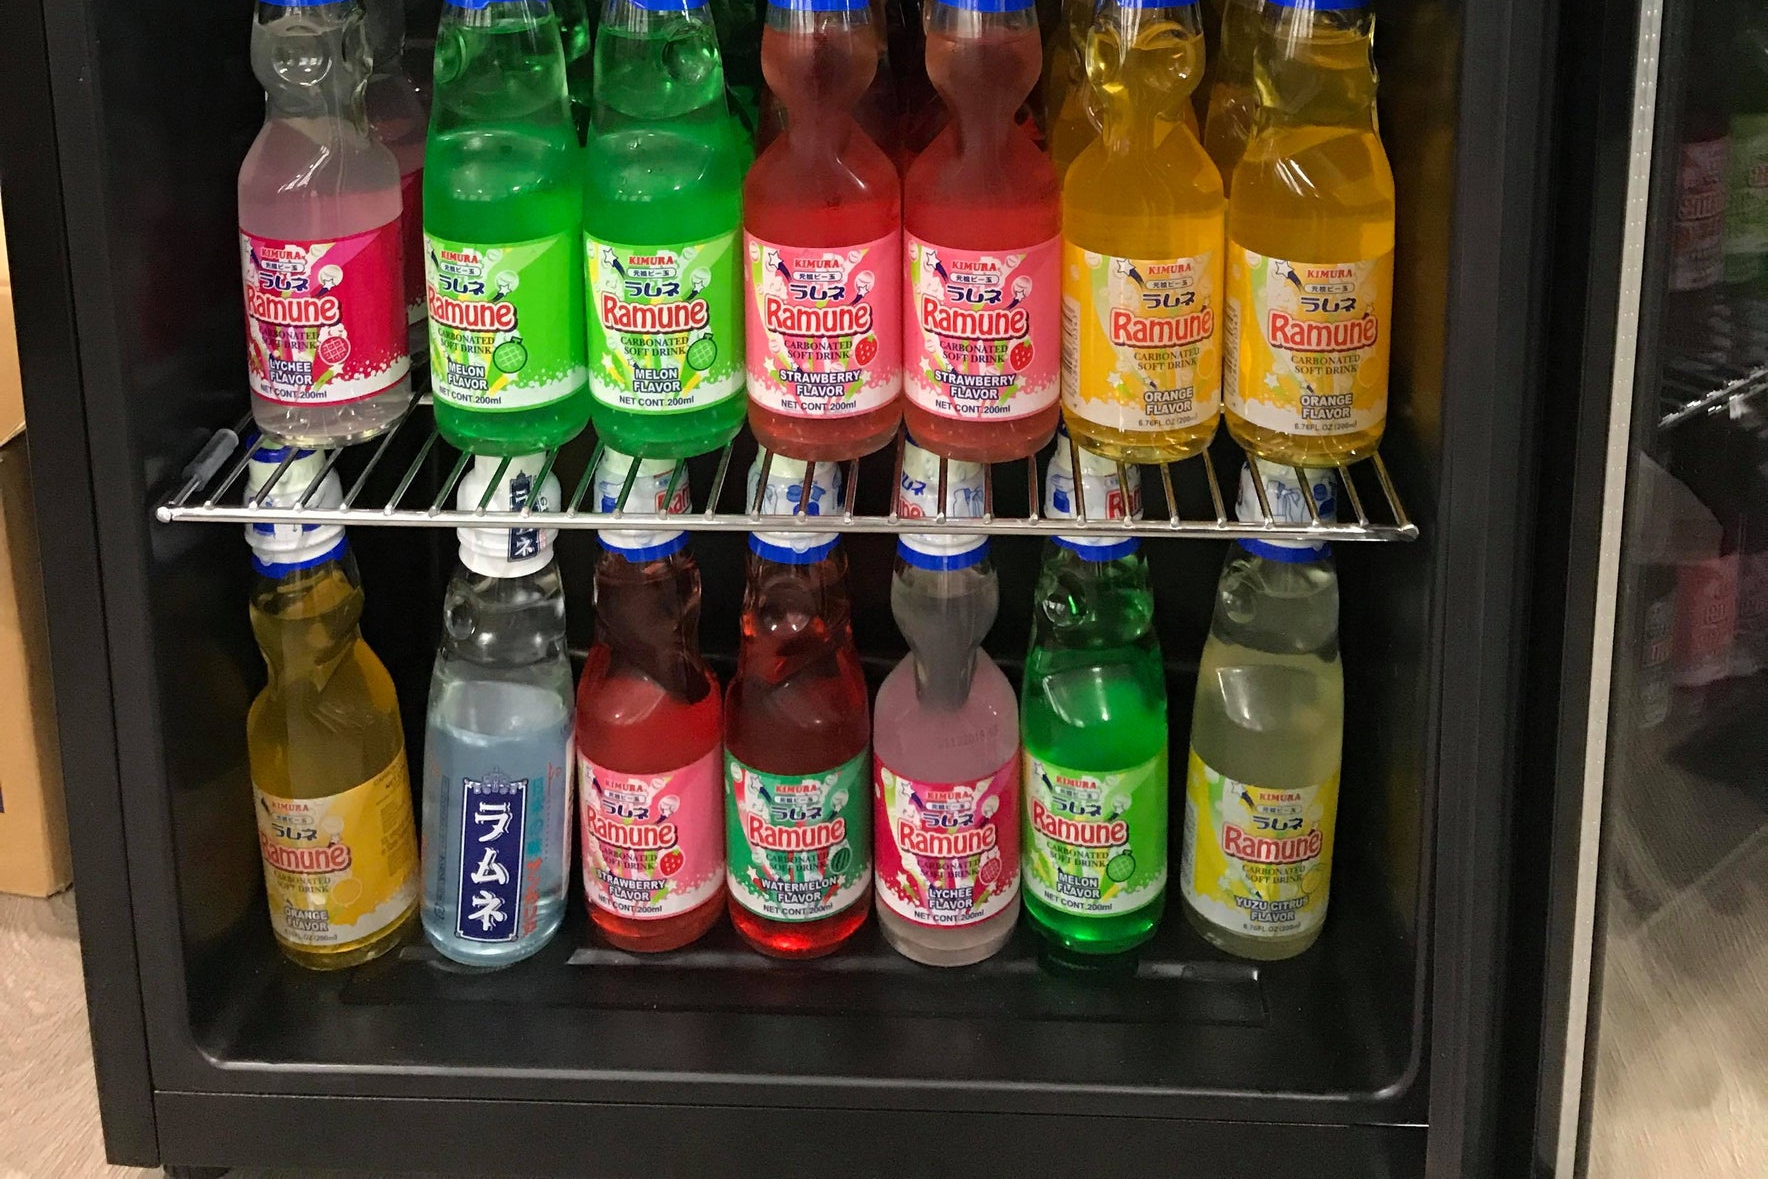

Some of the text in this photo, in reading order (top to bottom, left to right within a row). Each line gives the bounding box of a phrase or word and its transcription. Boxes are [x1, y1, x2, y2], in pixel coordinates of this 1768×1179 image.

[261, 249, 300, 260] KIMURA
[442, 251, 478, 263] KIMURA
[629, 256, 673, 265] KIMURA
[795, 259, 839, 268] KIMURA
[952, 261, 996, 271] KIMURA
[1149, 264, 1191, 274] KIMURA
[1307, 270, 1352, 278] KIMURA
[247, 286, 338, 323] Ramune
[428, 287, 515, 330] Ramune
[602, 294, 707, 331] Ramune
[766, 297, 871, 334] Ramune
[923, 297, 1027, 337] Ramune
[1112, 310, 1213, 346] Ramune
[1270, 312, 1376, 349] Ramune
[621, 337, 688, 347] CARBONATED
[785, 340, 852, 350] CARBONATED
[940, 341, 1008, 354] CARBONATED
[624, 348, 686, 356] SOFT DRINK
[788, 350, 850, 360] SOFT DRINK
[971, 354, 1005, 363] DRINK
[1134, 348, 1199, 361] CARBONATED
[269, 360, 311, 372] LYCHEE
[1167, 358, 1197, 369] DRINK
[1291, 355, 1360, 365] CARBONATED
[448, 362, 484, 376] MELON
[635, 369, 678, 380] MELON
[1326, 364, 1357, 374] DRINK
[270, 373, 312, 385] FLAVOR
[448, 374, 488, 390] FLAVOR
[780, 370, 861, 384] STRAWBERRY
[935, 370, 1016, 386] STRAWBERRY
[634, 381, 681, 392] FLAVOR
[797, 385, 844, 396] FLAVOR
[951, 386, 998, 399] FLAVOR
[620, 396, 635, 405] NET
[1144, 387, 1193, 402] ORANGE
[1301, 393, 1352, 406] ORANGE
[781, 400, 798, 409] NET
[936, 400, 951, 410] NET
[1146, 401, 1192, 415] FLAVOR
[1302, 407, 1351, 419] FLAVOR
[776, 784, 817, 793] KIMURA
[1056, 776, 1097, 789] KIMURA
[1260, 793, 1301, 801] KIMURA
[587, 804, 674, 847] Ramune
[1033, 800, 1126, 845] Ramune
[749, 815, 845, 849] Ramune
[900, 822, 996, 856] Ramune
[1224, 824, 1321, 862] Ramune
[260, 834, 349, 871] Ramune
[468, 801, 513, 931] ラムネ
[597, 868, 667, 890] STRAWBERRY
[762, 876, 837, 892] WATERMELON
[1058, 872, 1098, 887] MELON
[609, 887, 650, 901] FLAVOR
[778, 892, 821, 903] FLAVOR
[929, 887, 973, 899] LYCHEE
[1057, 884, 1100, 899] FLAVOR
[929, 899, 973, 910] FLAVOR
[1235, 895, 1309, 912] YUZU CITRUS
[284, 906, 328, 920] ORANGE
[1251, 911, 1295, 922] FLAVOR
[287, 918, 328, 931] FLAVOR
